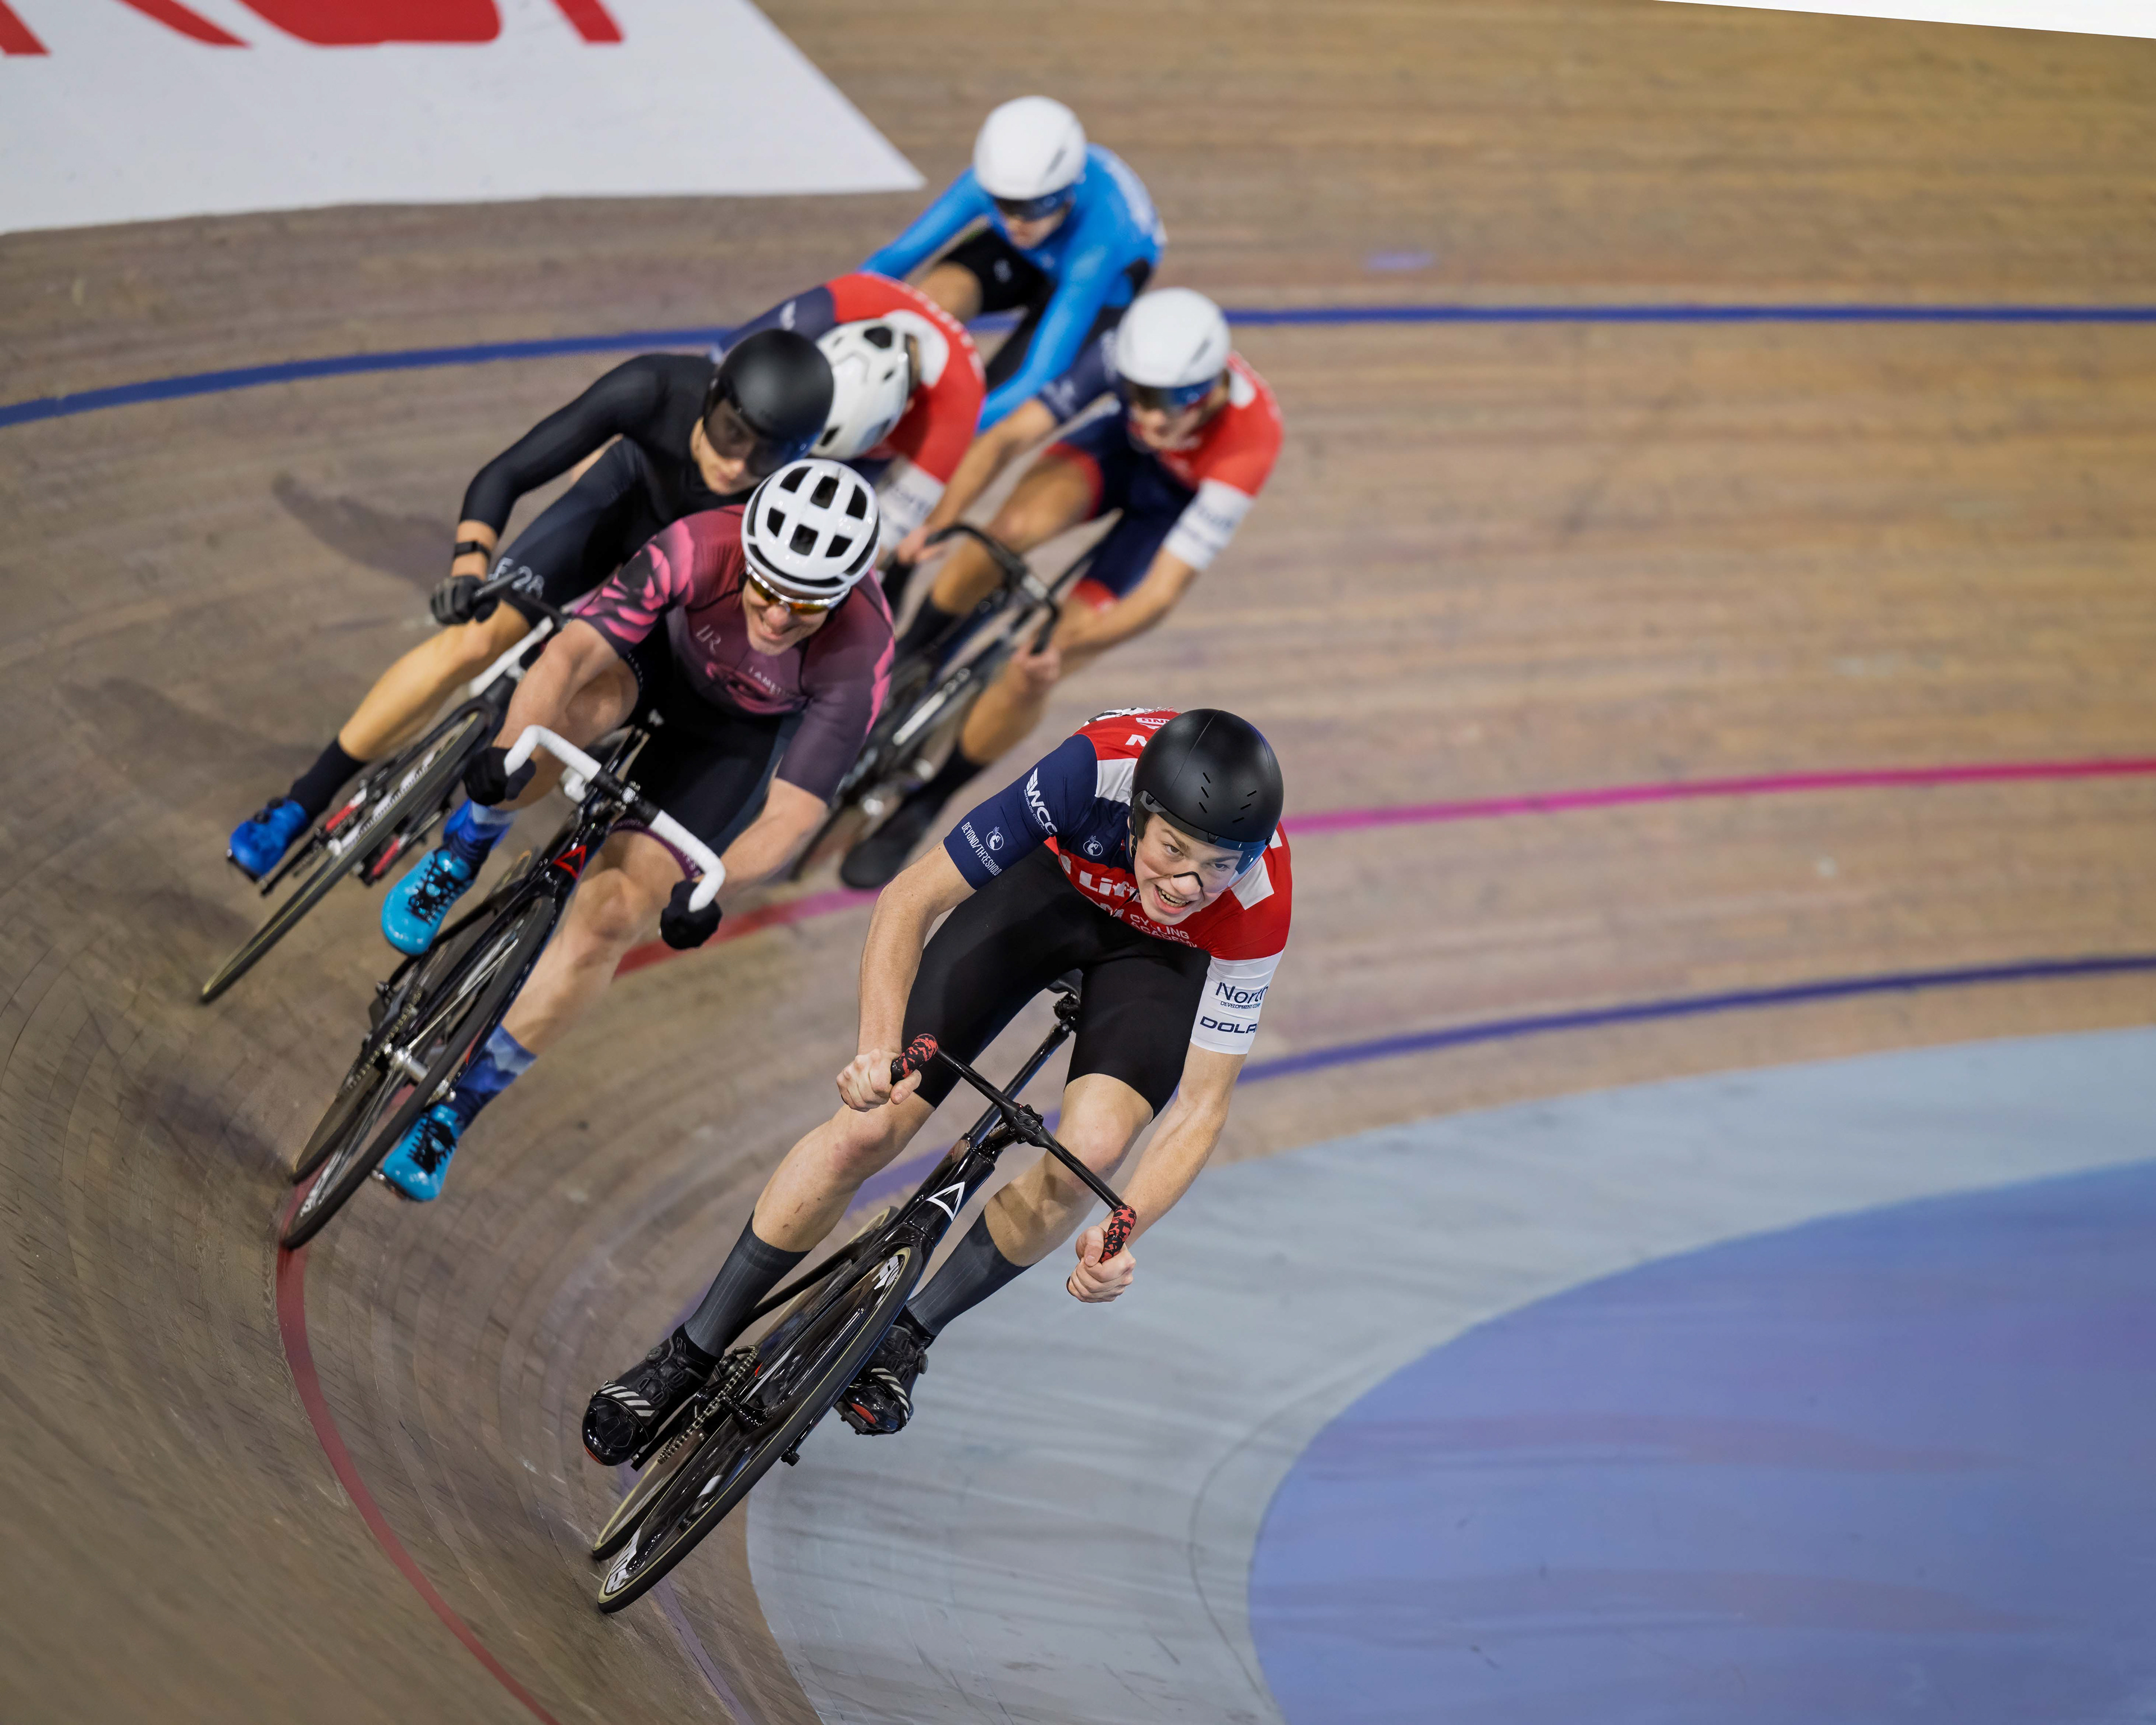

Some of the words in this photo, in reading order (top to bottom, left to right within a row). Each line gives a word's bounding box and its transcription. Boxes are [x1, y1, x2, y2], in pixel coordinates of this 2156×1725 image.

[1024, 789, 1034, 813] WATERLOO
[1026, 777, 1058, 835] WCC
[1220, 1001, 1253, 1010] DEVELOPMENT
